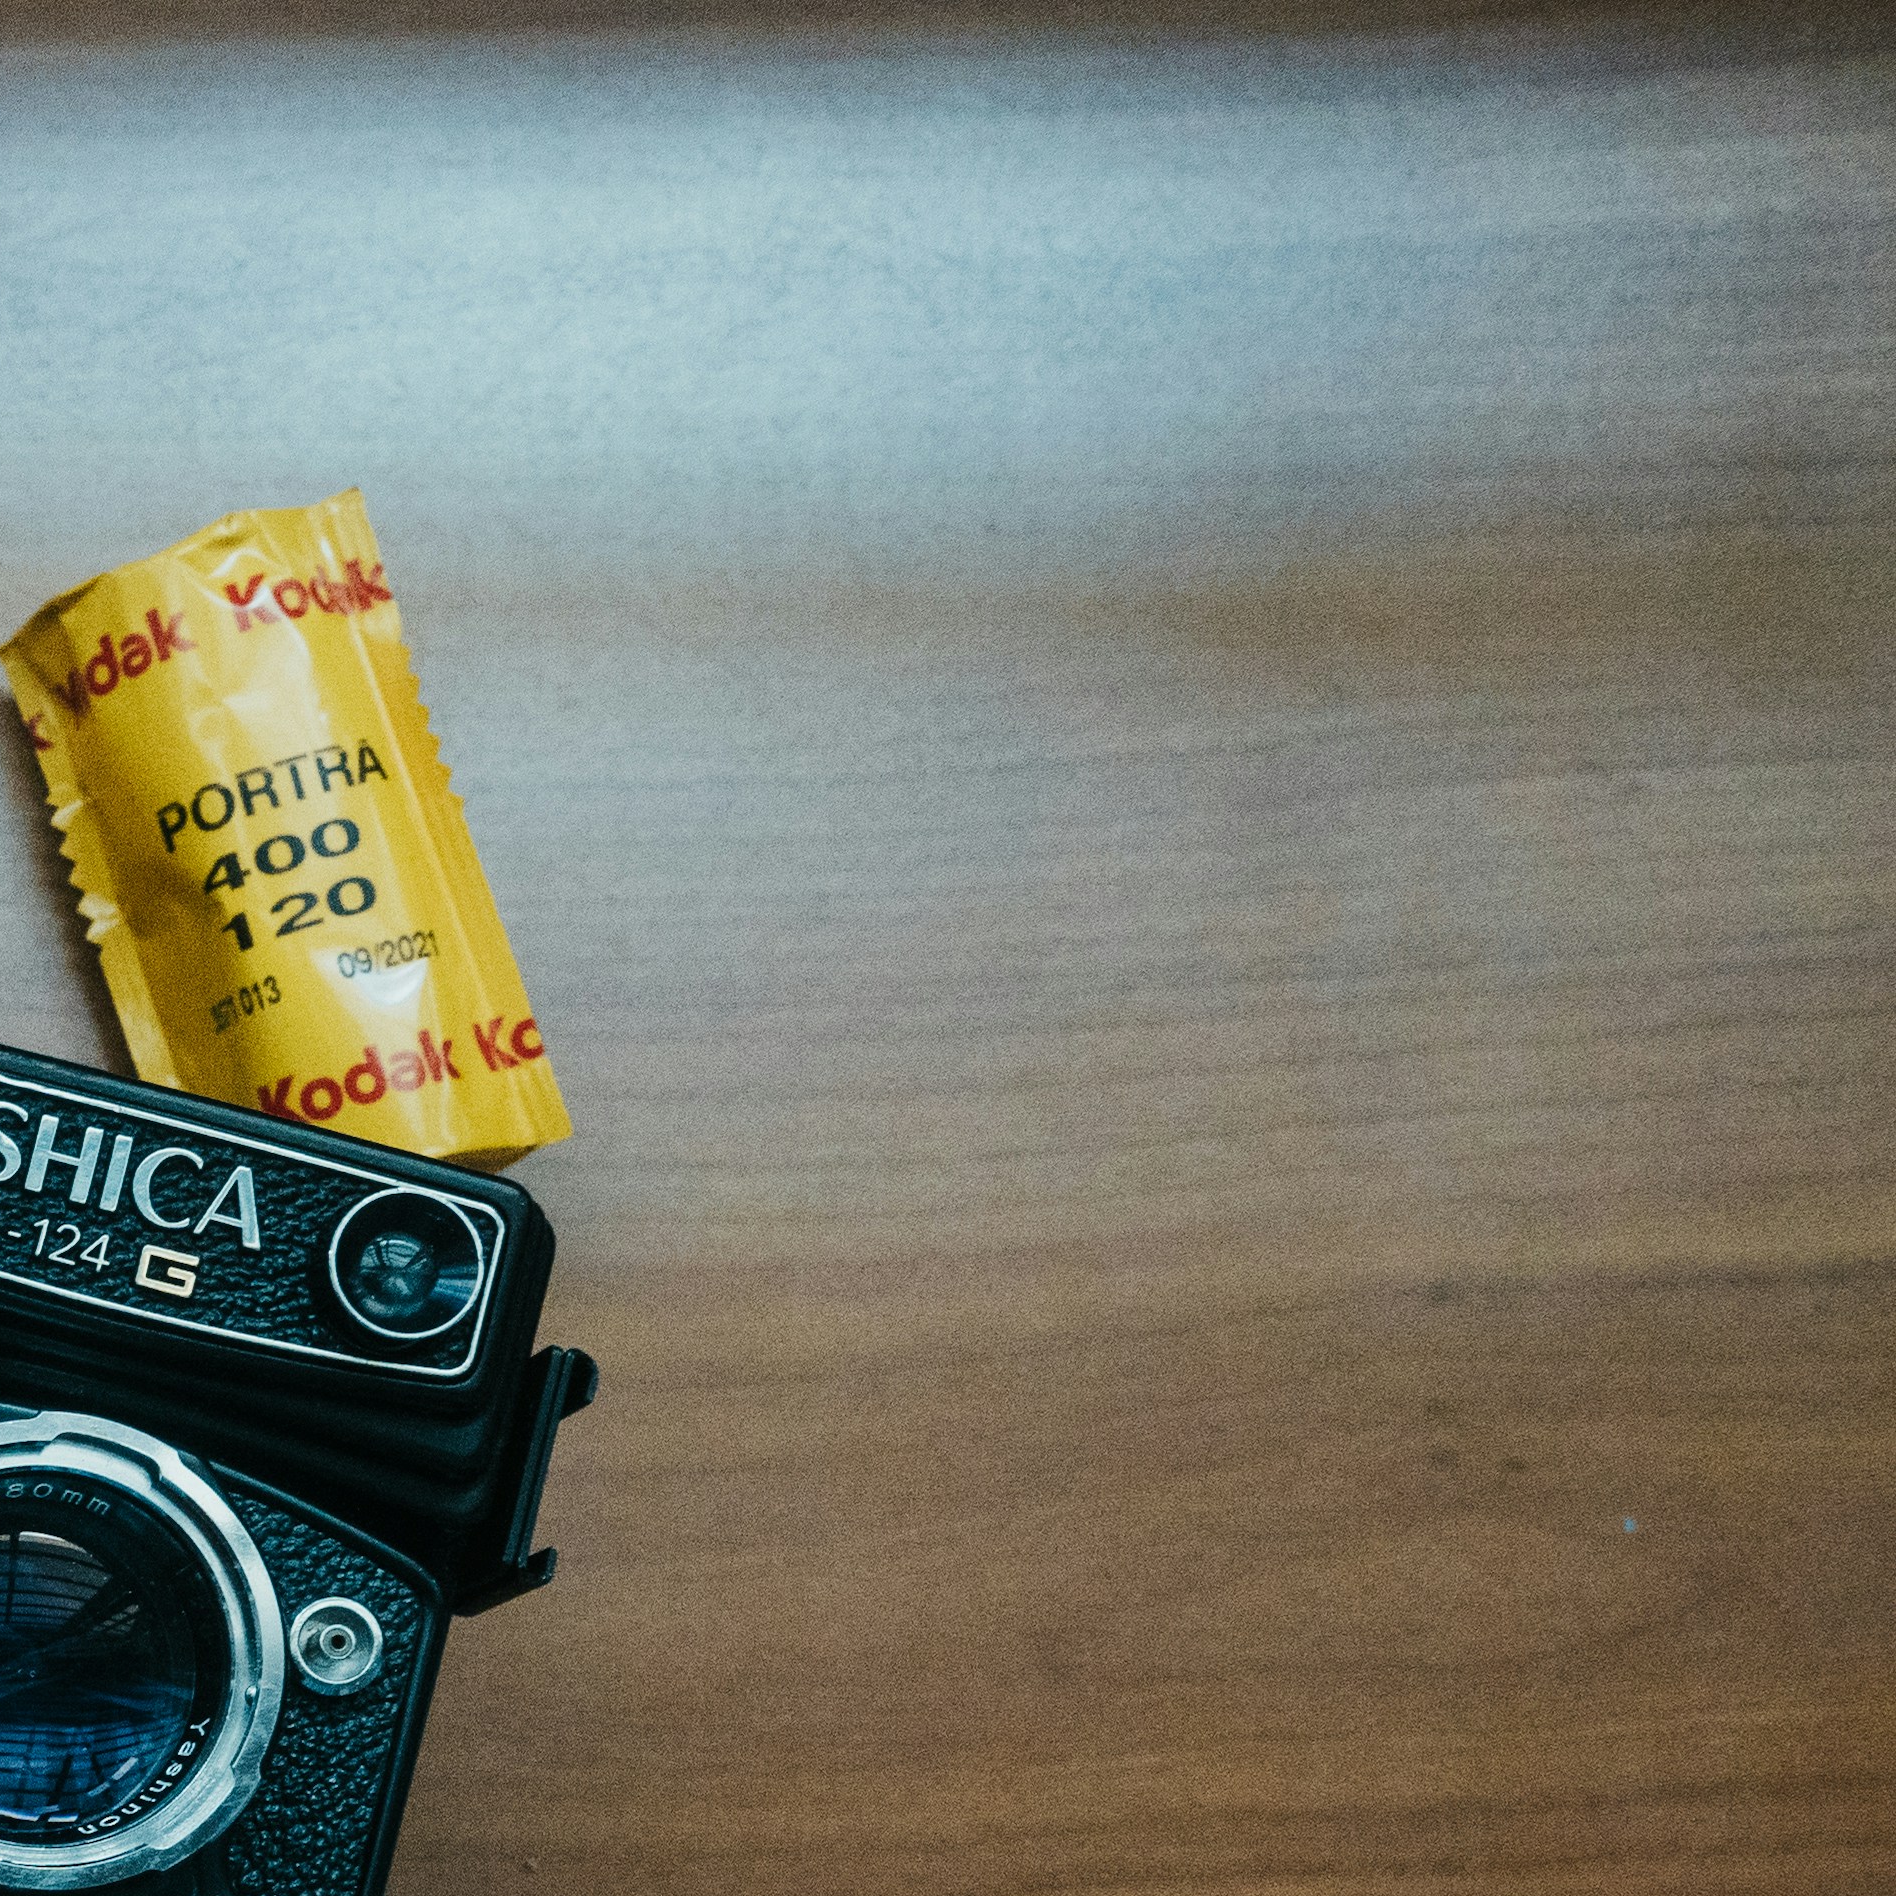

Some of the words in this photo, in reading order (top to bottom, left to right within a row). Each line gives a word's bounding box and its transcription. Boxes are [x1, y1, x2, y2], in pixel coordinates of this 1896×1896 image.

[156, 739, 389, 853] PORTRA
[204, 818, 361, 895] 400
[222, 876, 377, 954] 120
[336, 929, 440, 979] 09/2021
[258, 1030, 460, 1123] Kodak
[135, 1244, 200, 1299] G
[77, 1717, 211, 1836] Yashinon
